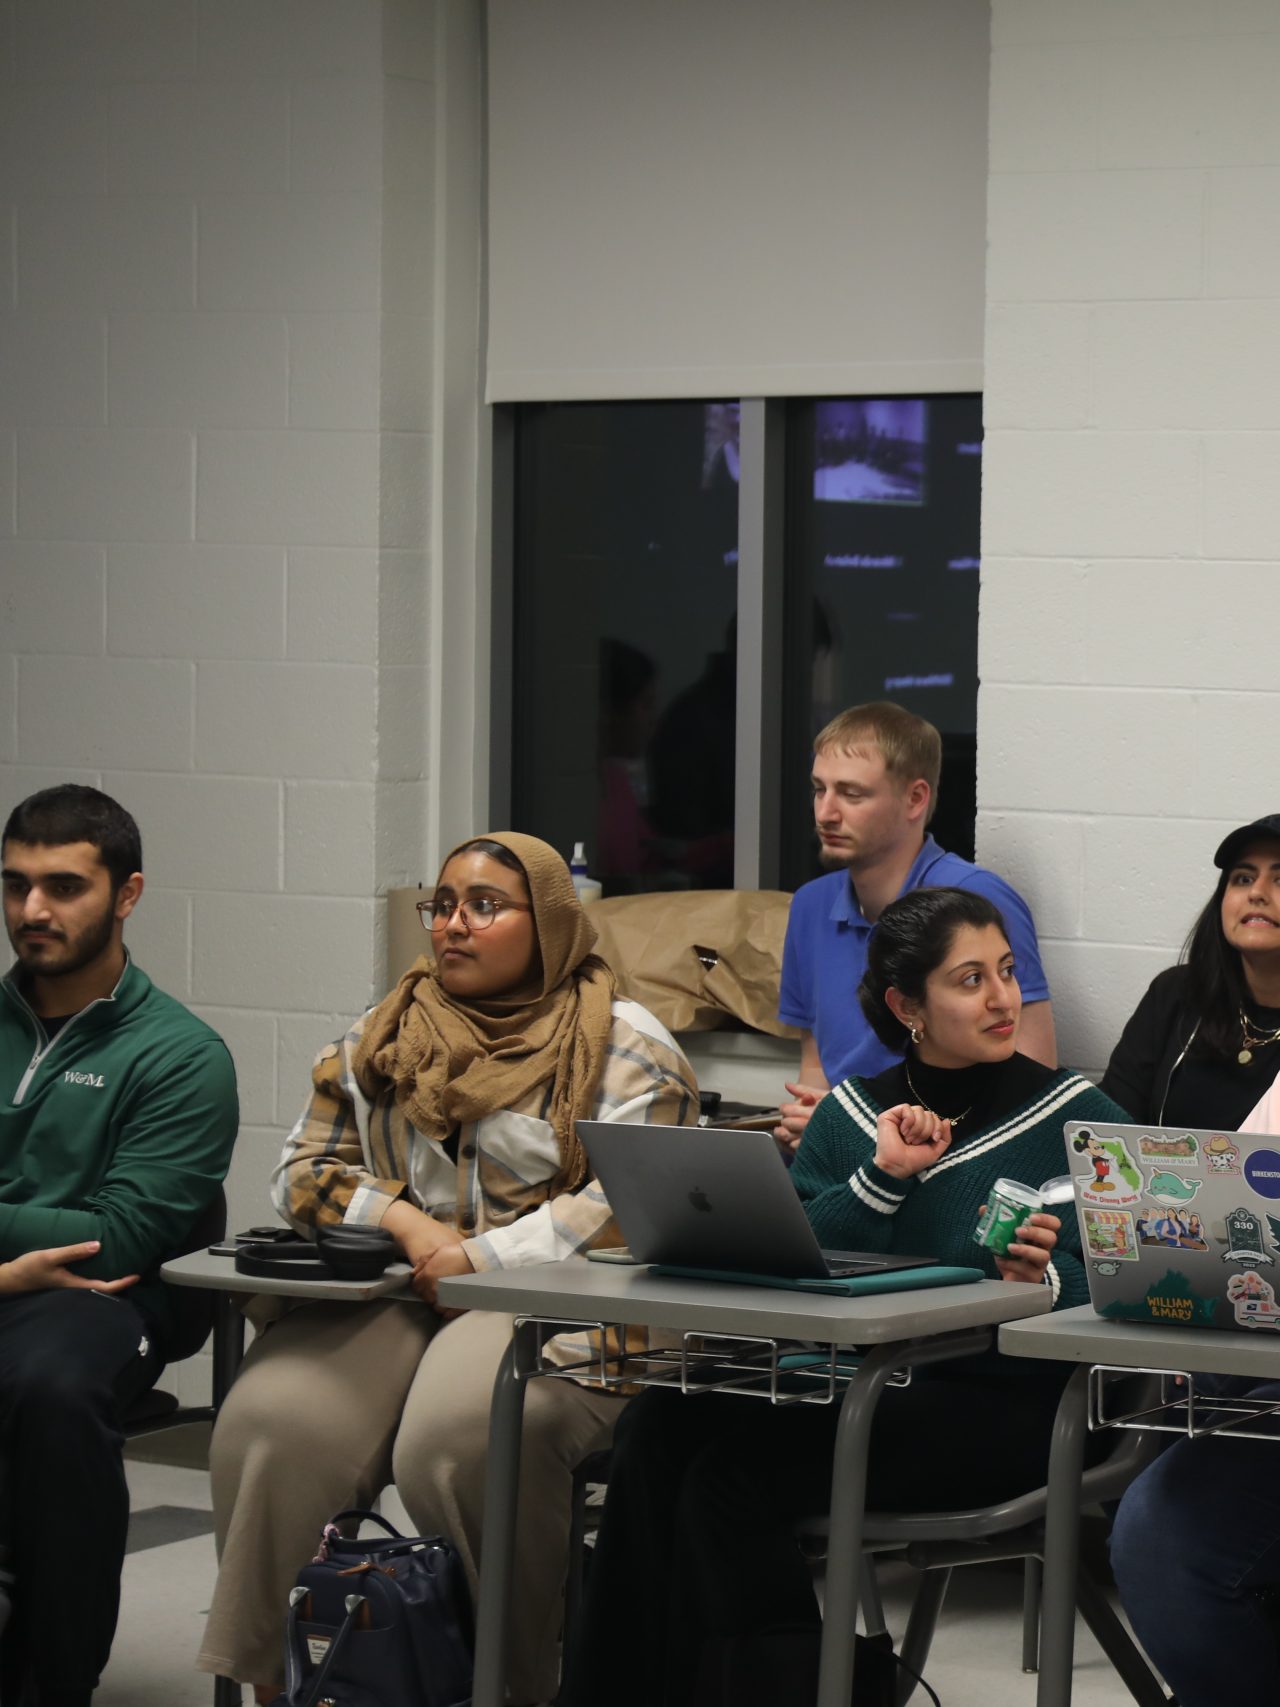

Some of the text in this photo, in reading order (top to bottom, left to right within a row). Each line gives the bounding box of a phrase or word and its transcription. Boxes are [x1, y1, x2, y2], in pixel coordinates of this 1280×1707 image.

[64, 1071, 104, 1087] W&M
[1234, 1221, 1254, 1230] 330
[1147, 1296, 1194, 1309] WILLIAM
